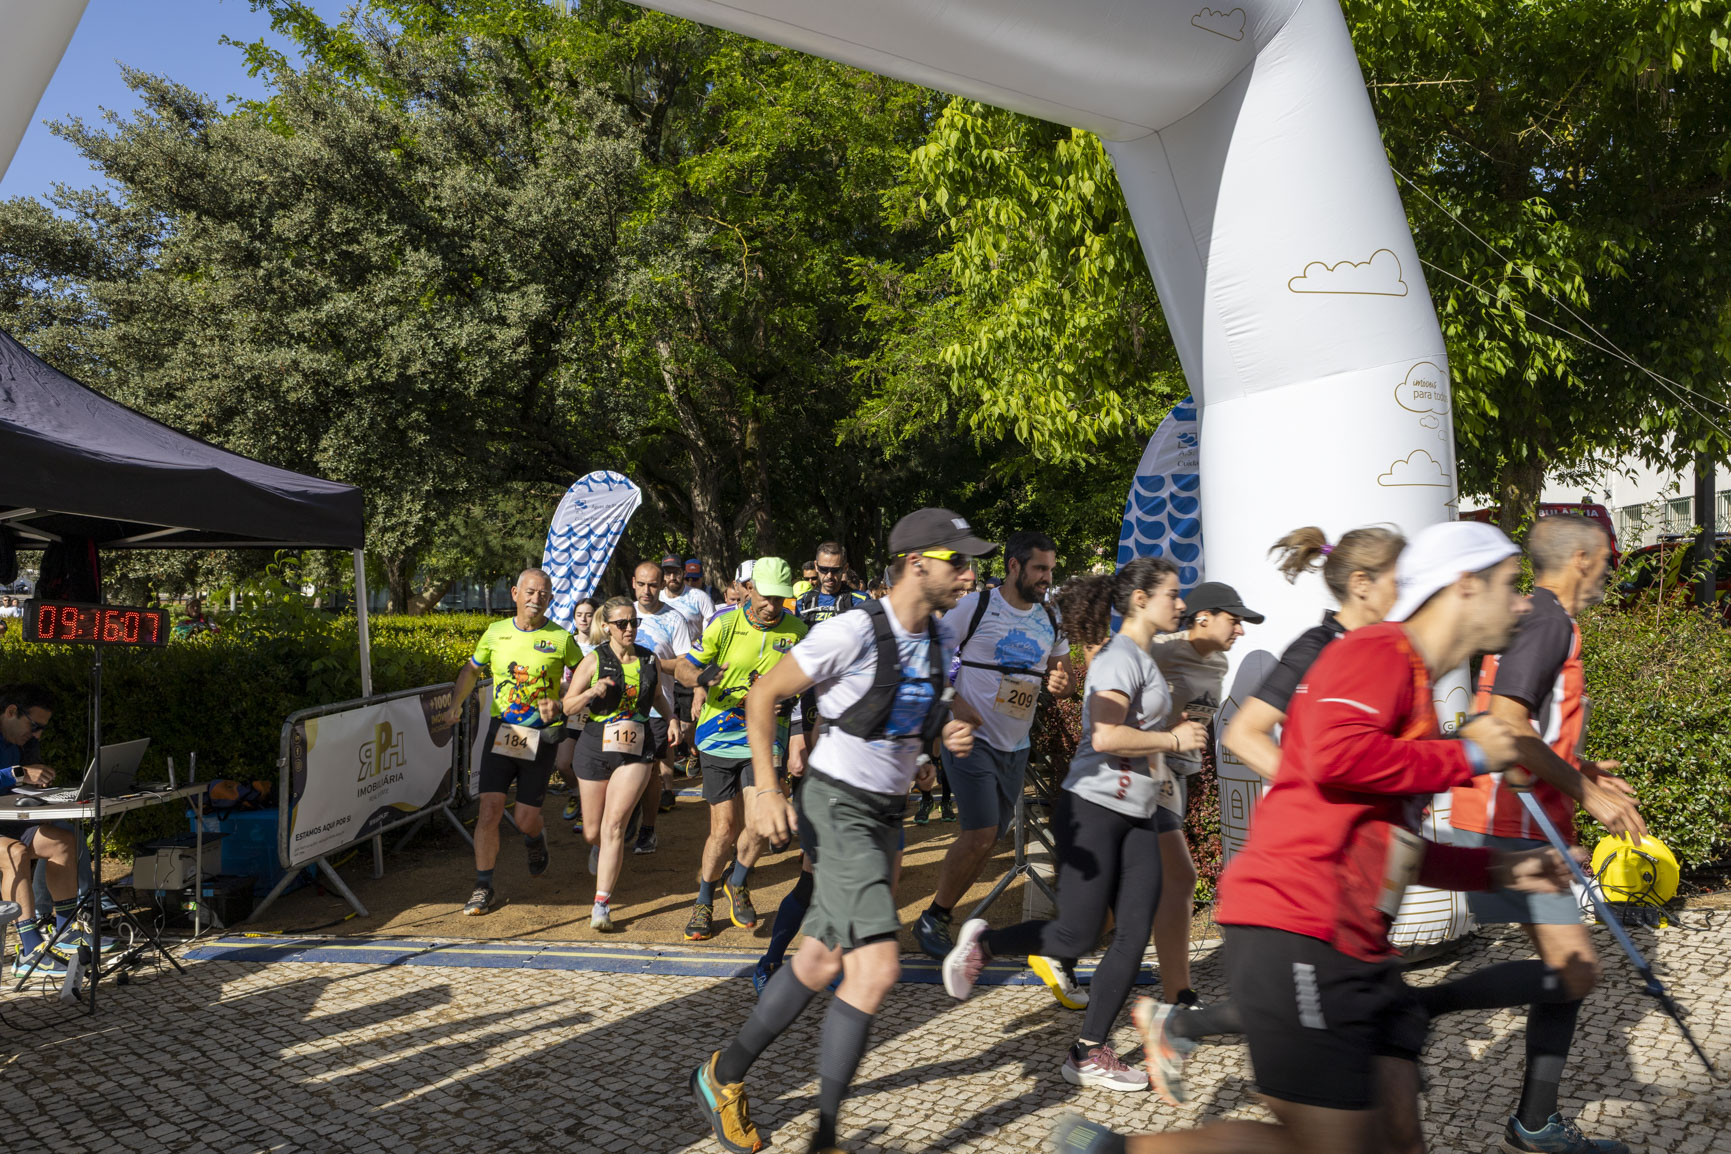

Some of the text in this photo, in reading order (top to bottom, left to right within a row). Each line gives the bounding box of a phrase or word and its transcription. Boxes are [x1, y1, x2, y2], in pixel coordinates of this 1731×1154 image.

[1413, 390, 1432, 400] para
[38, 605, 158, 643] 09:16:07
[1007, 689, 1033, 708] 209
[504, 733, 528, 748] 184
[613, 730, 637, 744] 112
[296, 825, 322, 841] ESTAMOS
[322, 821, 336, 832] AQUI
[336, 817, 347, 828] POR
